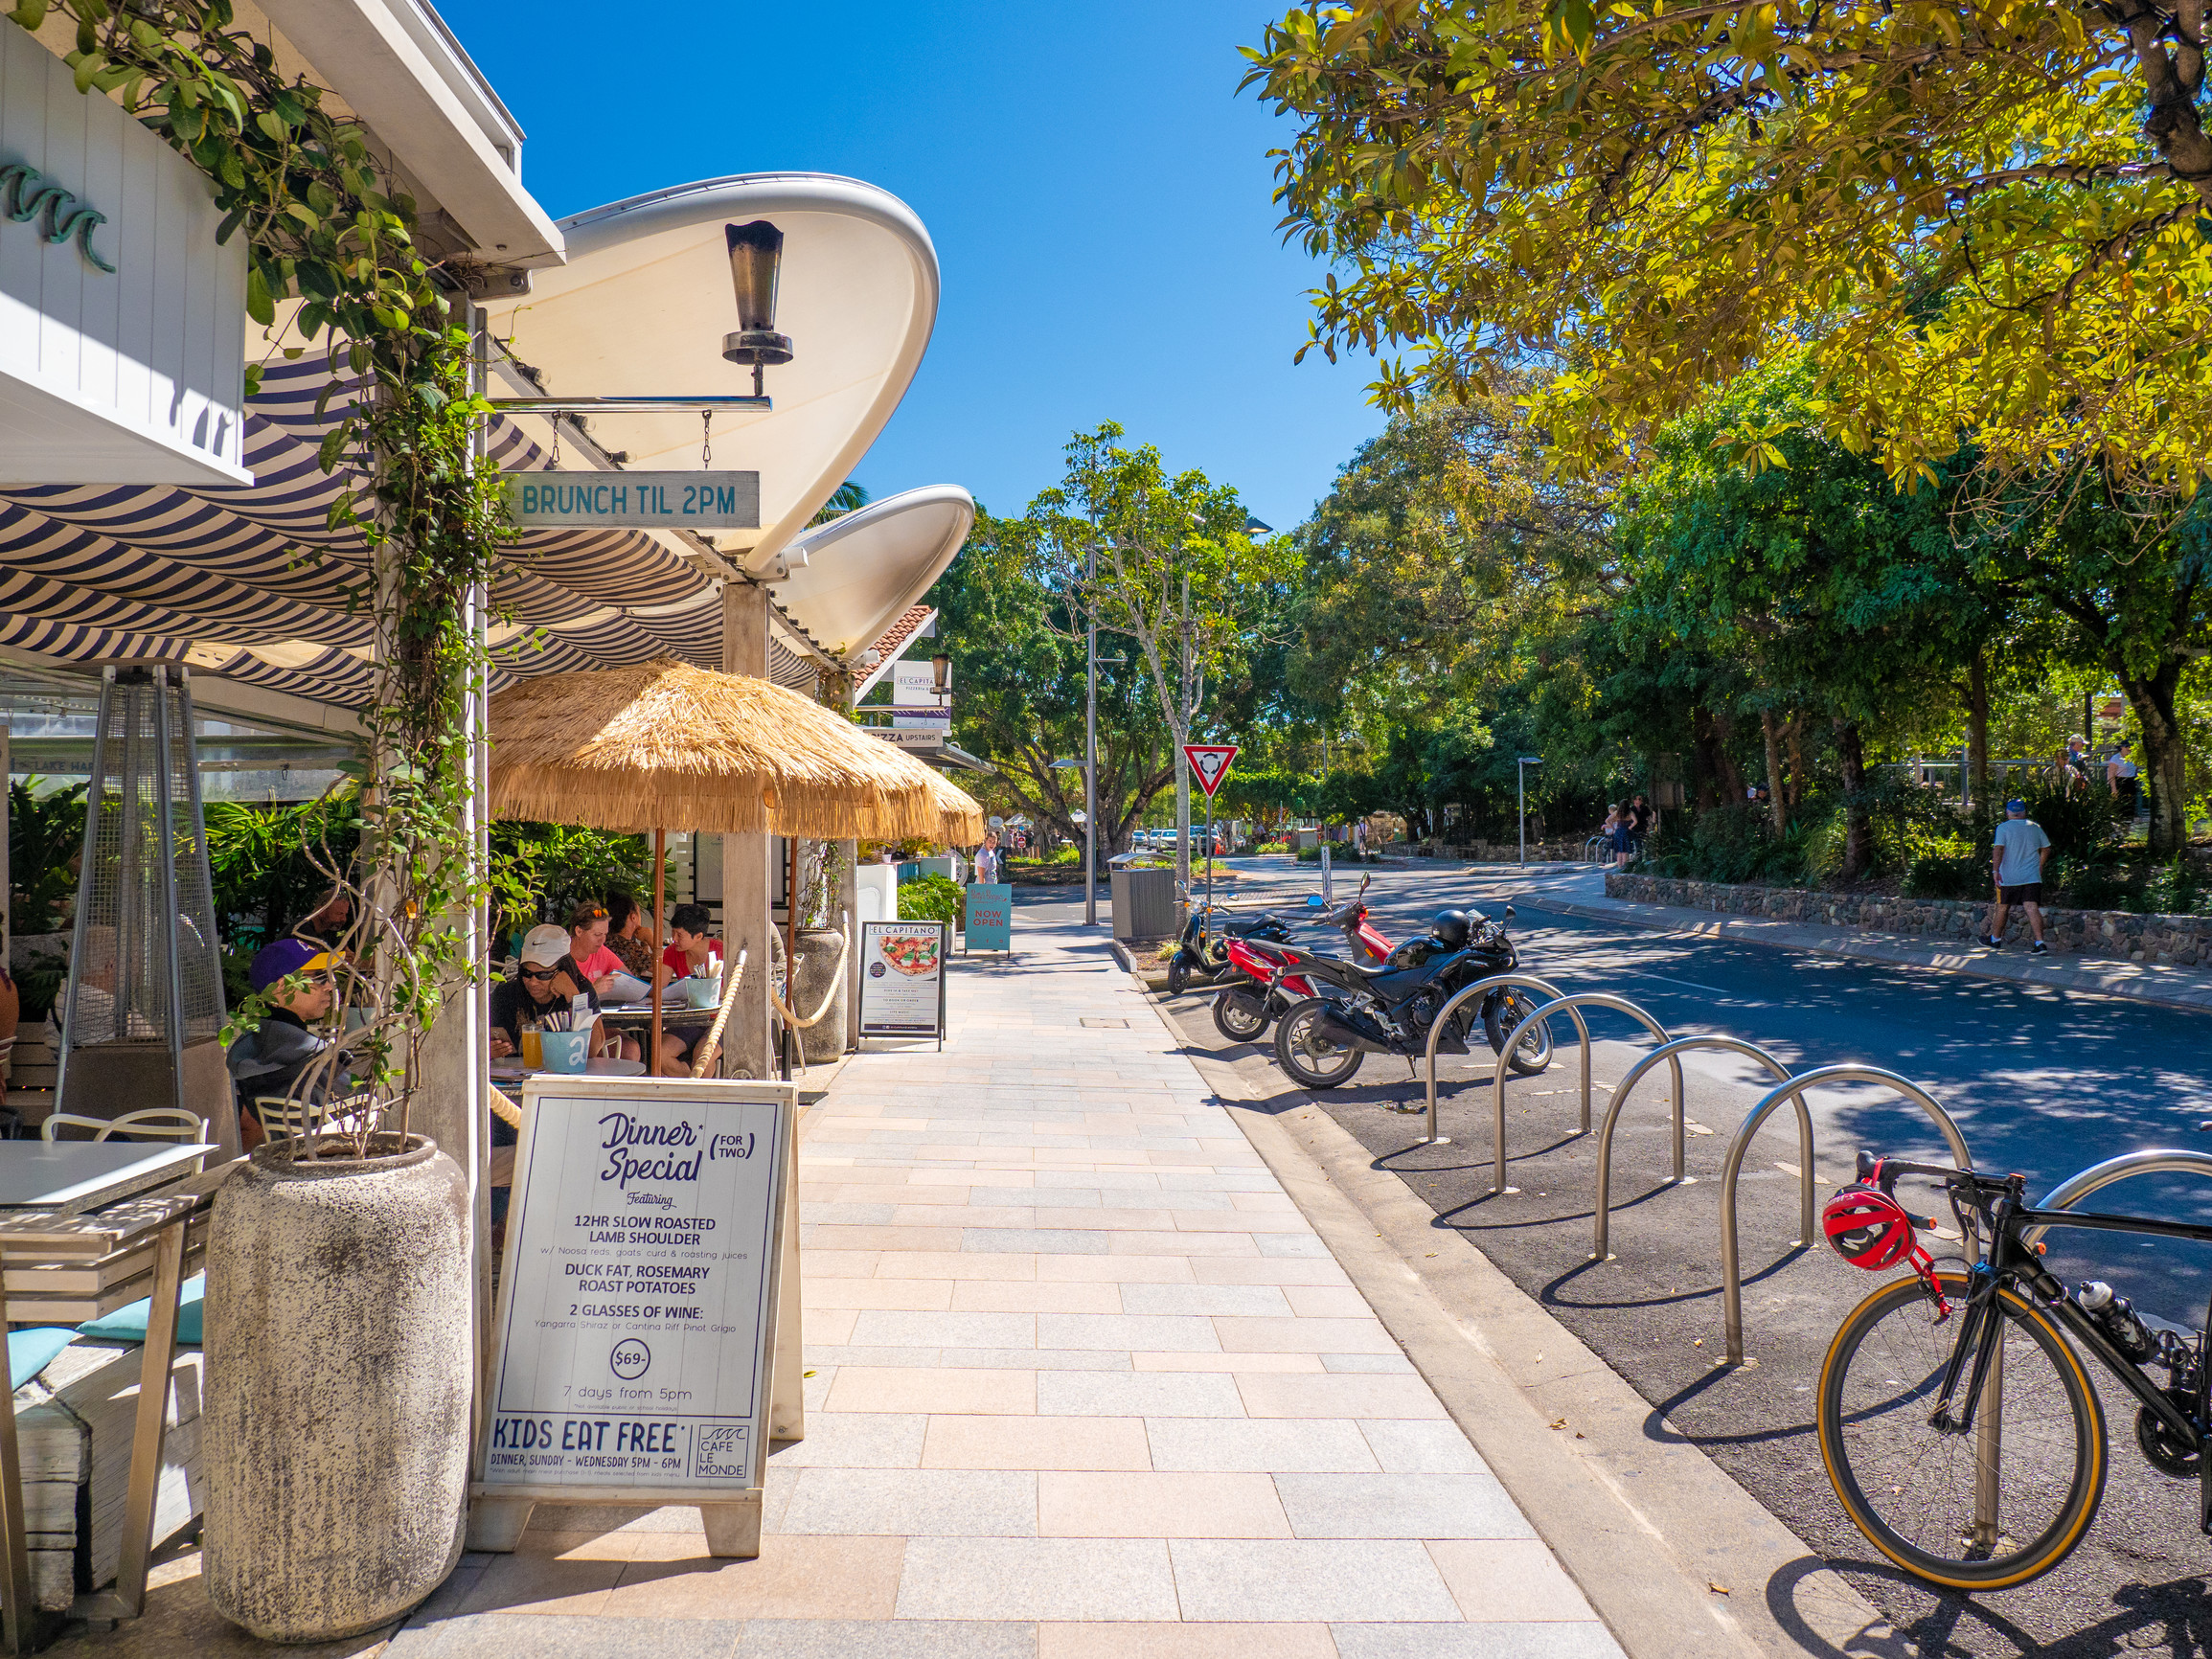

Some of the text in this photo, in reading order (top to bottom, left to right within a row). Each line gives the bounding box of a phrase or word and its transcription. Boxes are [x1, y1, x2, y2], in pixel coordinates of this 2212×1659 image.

[523, 486, 736, 514] BRUNCH TIL 2PM
[975, 910, 1002, 919] NOW
[873, 925, 935, 935] EL CAPITANO
[601, 1147, 703, 1190] Special
[627, 1191, 677, 1211] Featuring
[574, 1215, 716, 1231] 12HR SLOW ROASTED
[589, 1231, 700, 1245] LAMB SHOULDER
[540, 1246, 555, 1255] w/
[559, 1247, 586, 1256] Noosa
[646, 1249, 666, 1258] curd
[681, 1250, 717, 1261] roasting
[721, 1251, 747, 1261] juices
[565, 1262, 710, 1279] DUCK FAT, ROSEMARY
[579, 1280, 696, 1294] ROAST POTATOES
[569, 1304, 704, 1319] 2 GLASSES OF WINE:
[535, 1320, 576, 1330] Yangarra
[580, 1320, 607, 1329] Shiraz
[626, 1322, 661, 1331] Cantina
[665, 1323, 680, 1331] Riff
[683, 1323, 706, 1332] Pinot
[710, 1325, 737, 1334] Grigio
[614, 1351, 646, 1367] $69-
[563, 1385, 693, 1402] 7 days from 5pm
[491, 1418, 553, 1450] KIDS
[561, 1420, 611, 1452] EAT
[699, 1441, 733, 1452] CAFE
[490, 1453, 527, 1467] DINNER,
[529, 1454, 564, 1467] SUNDAY
[575, 1456, 629, 1468] WEDNESDAY
[631, 1456, 650, 1468] 5PM
[661, 1457, 681, 1469] 6PM
[699, 1452, 714, 1464] LE
[697, 1465, 743, 1476] MONDE
